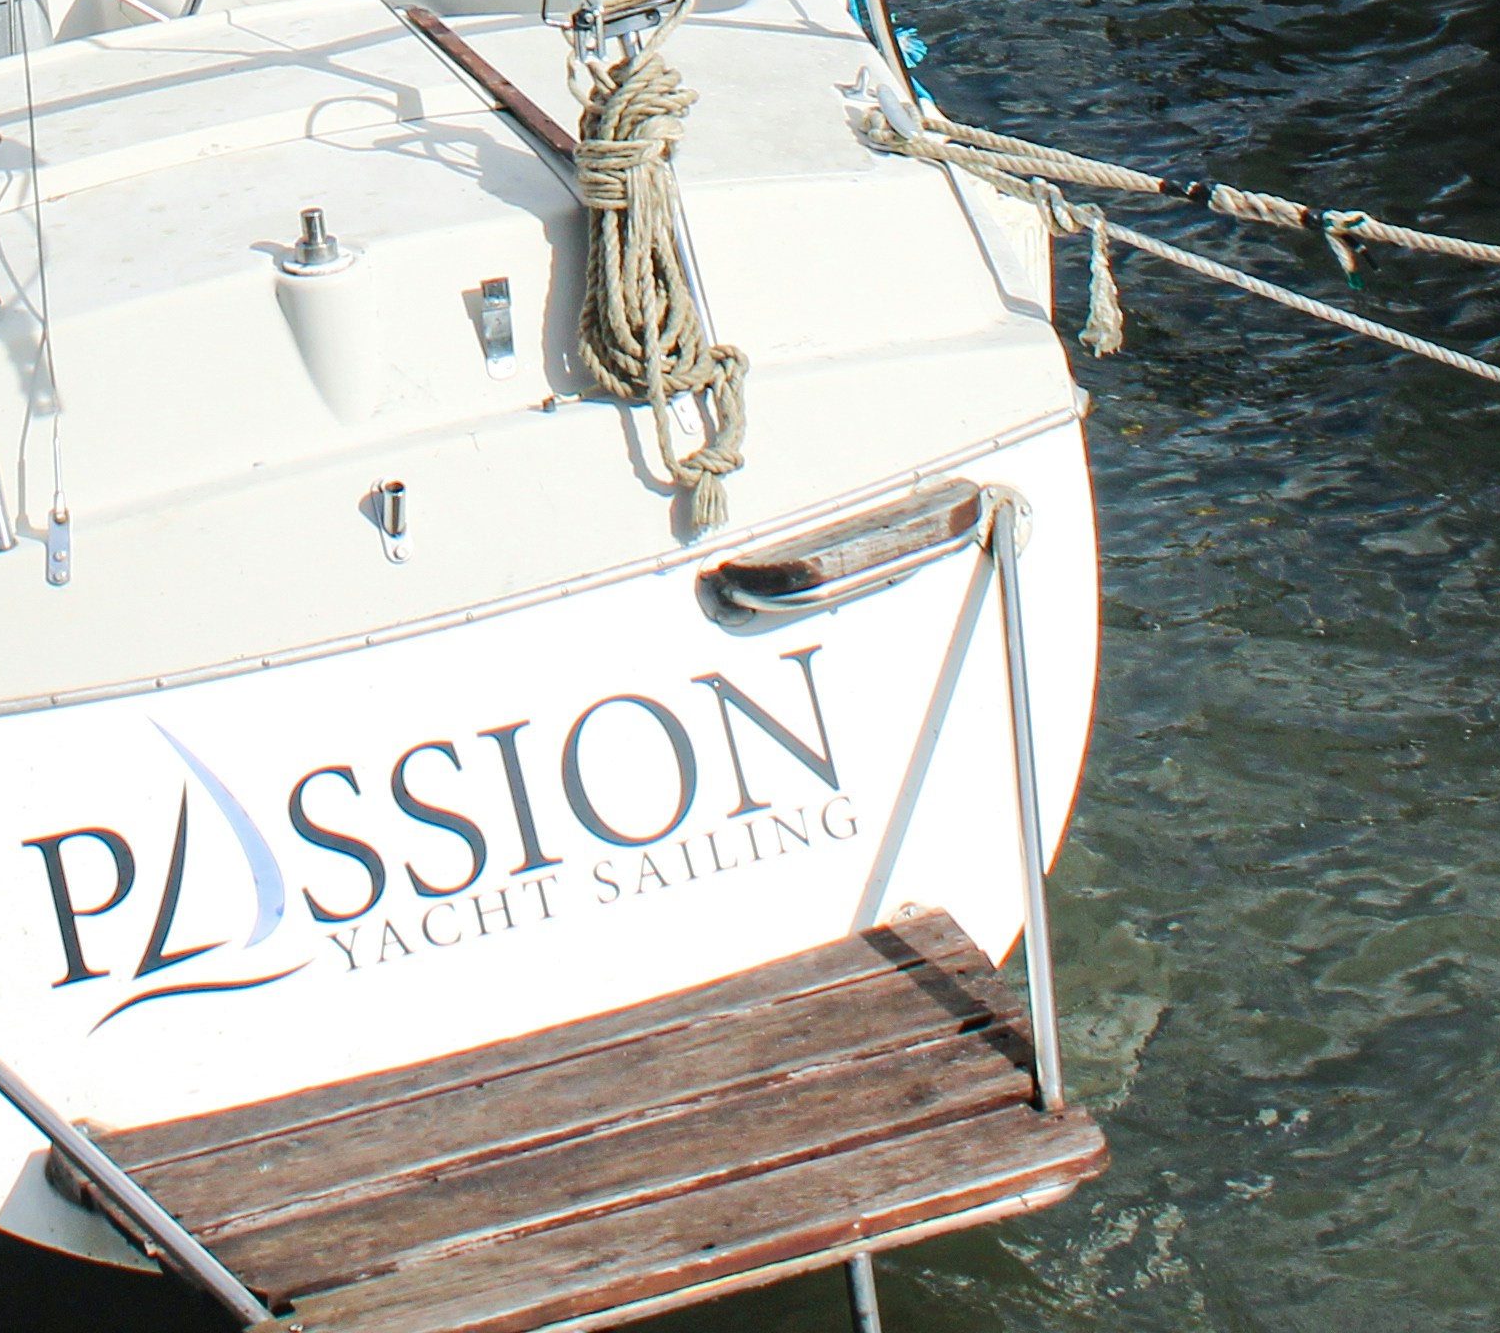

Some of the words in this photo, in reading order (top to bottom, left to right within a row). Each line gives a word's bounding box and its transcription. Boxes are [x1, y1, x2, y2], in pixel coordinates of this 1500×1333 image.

[20, 644, 841, 990] PASSION
[326, 874, 560, 973] YACHT
[595, 796, 860, 906] SAILING
